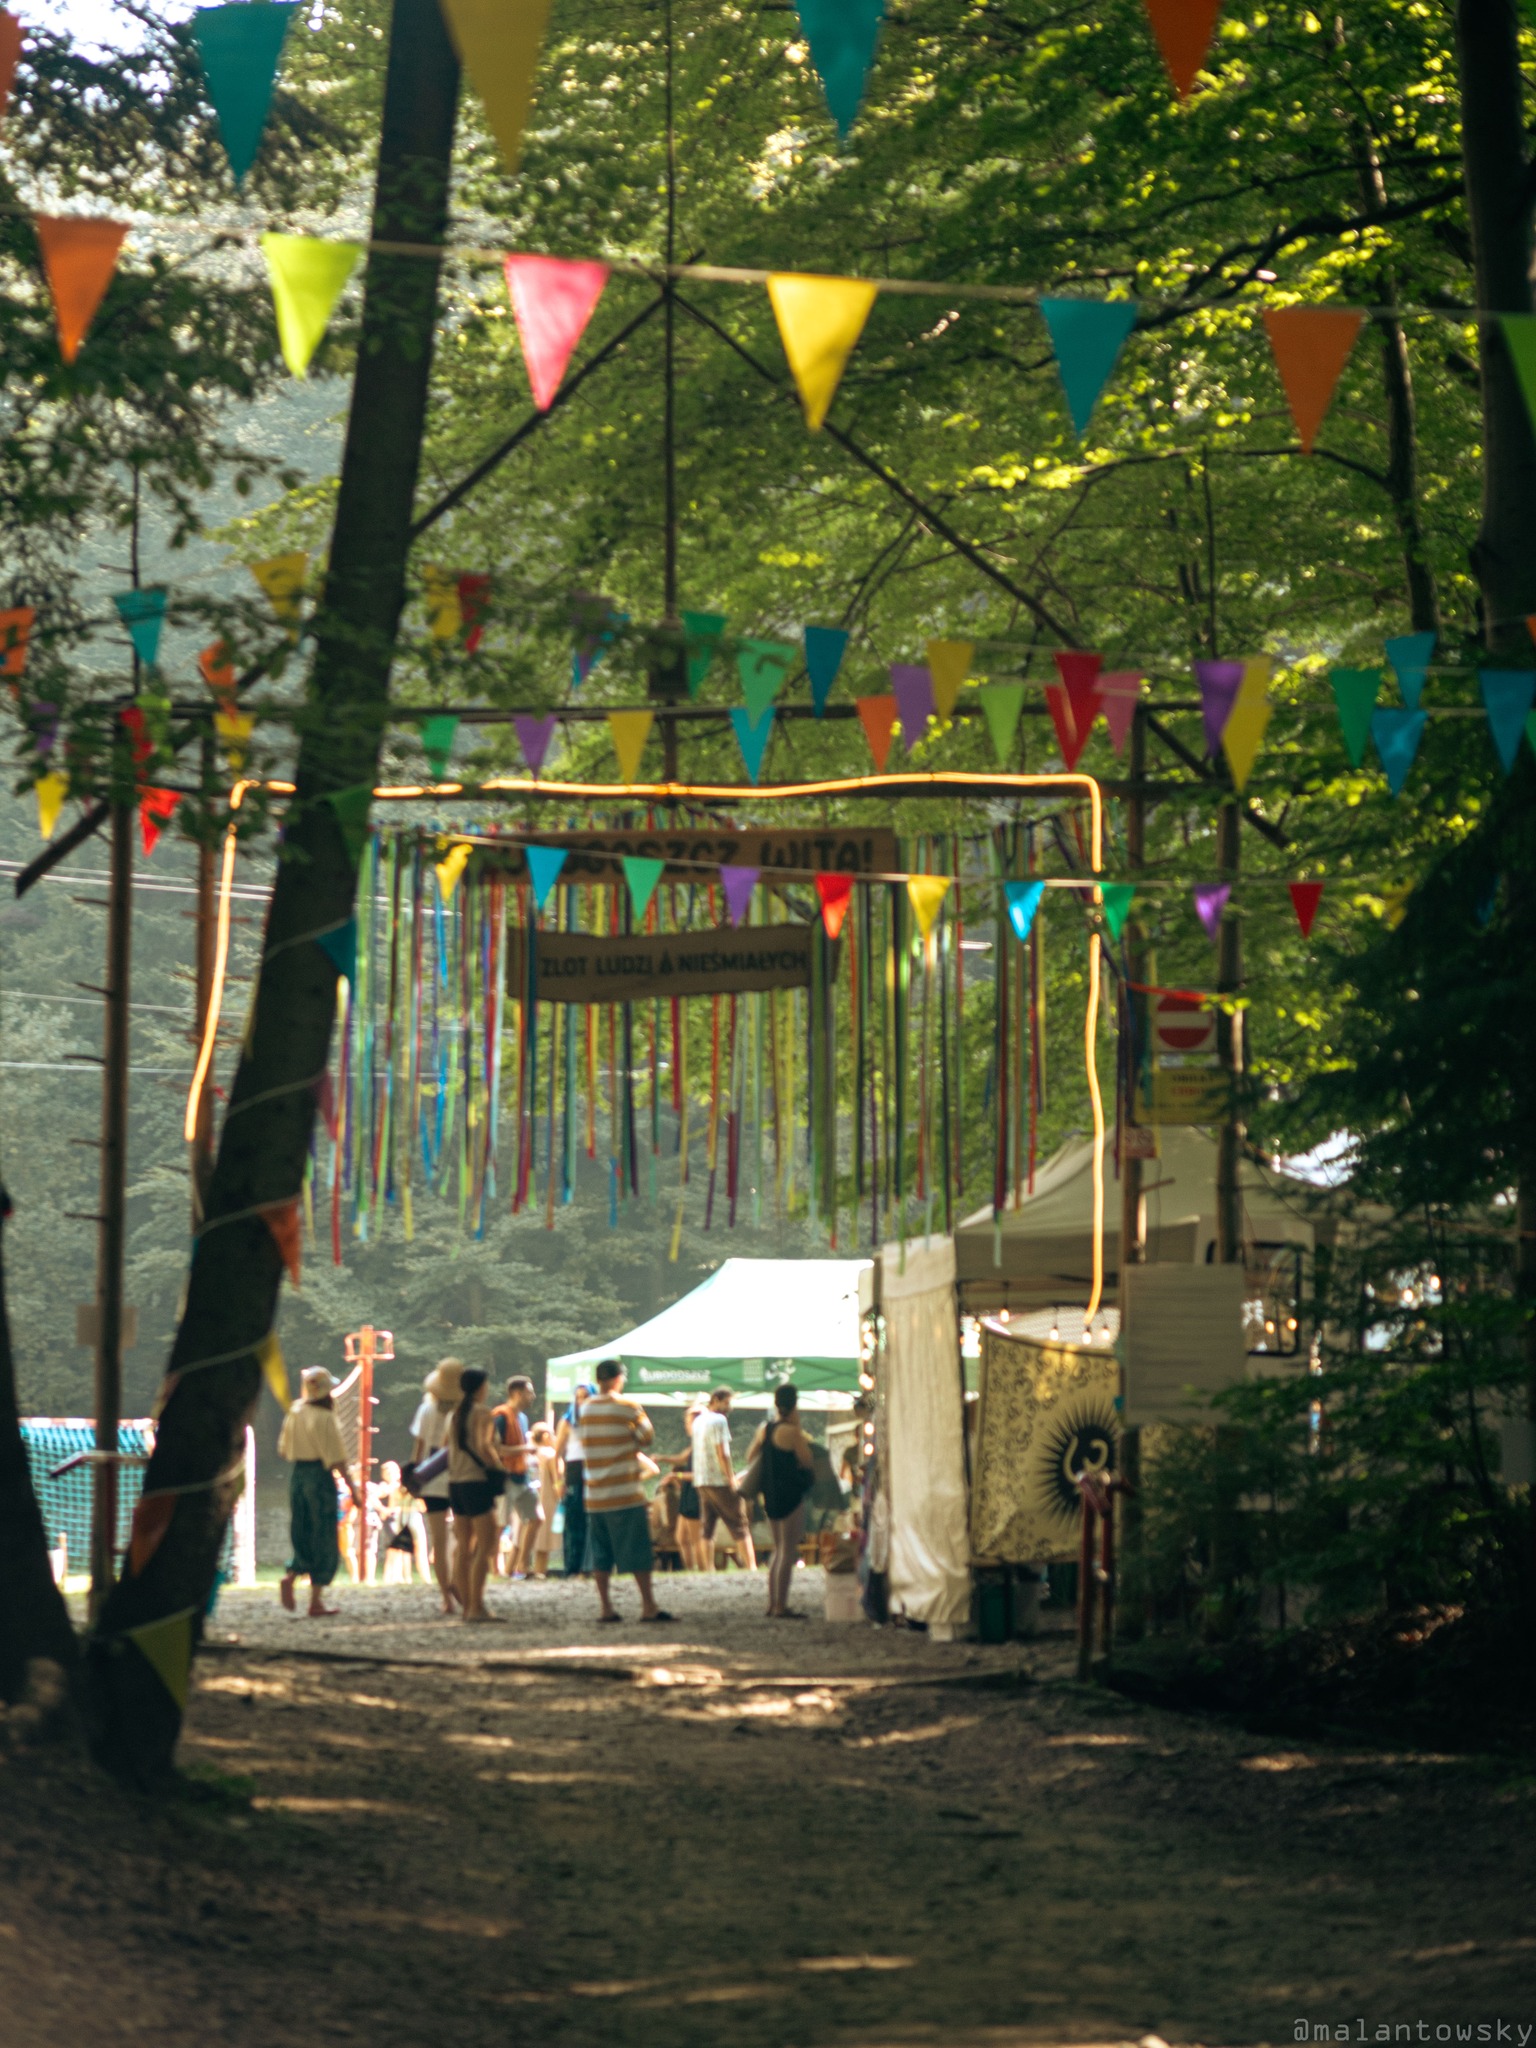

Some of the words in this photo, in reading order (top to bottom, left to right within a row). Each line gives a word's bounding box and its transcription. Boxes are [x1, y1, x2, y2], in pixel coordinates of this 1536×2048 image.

[760, 837, 872, 872] WITA!
[541, 956, 586, 977] ZLOT
[595, 954, 653, 976] LUDZI
[677, 949, 808, 973] NIEŚMIAŁYCH
